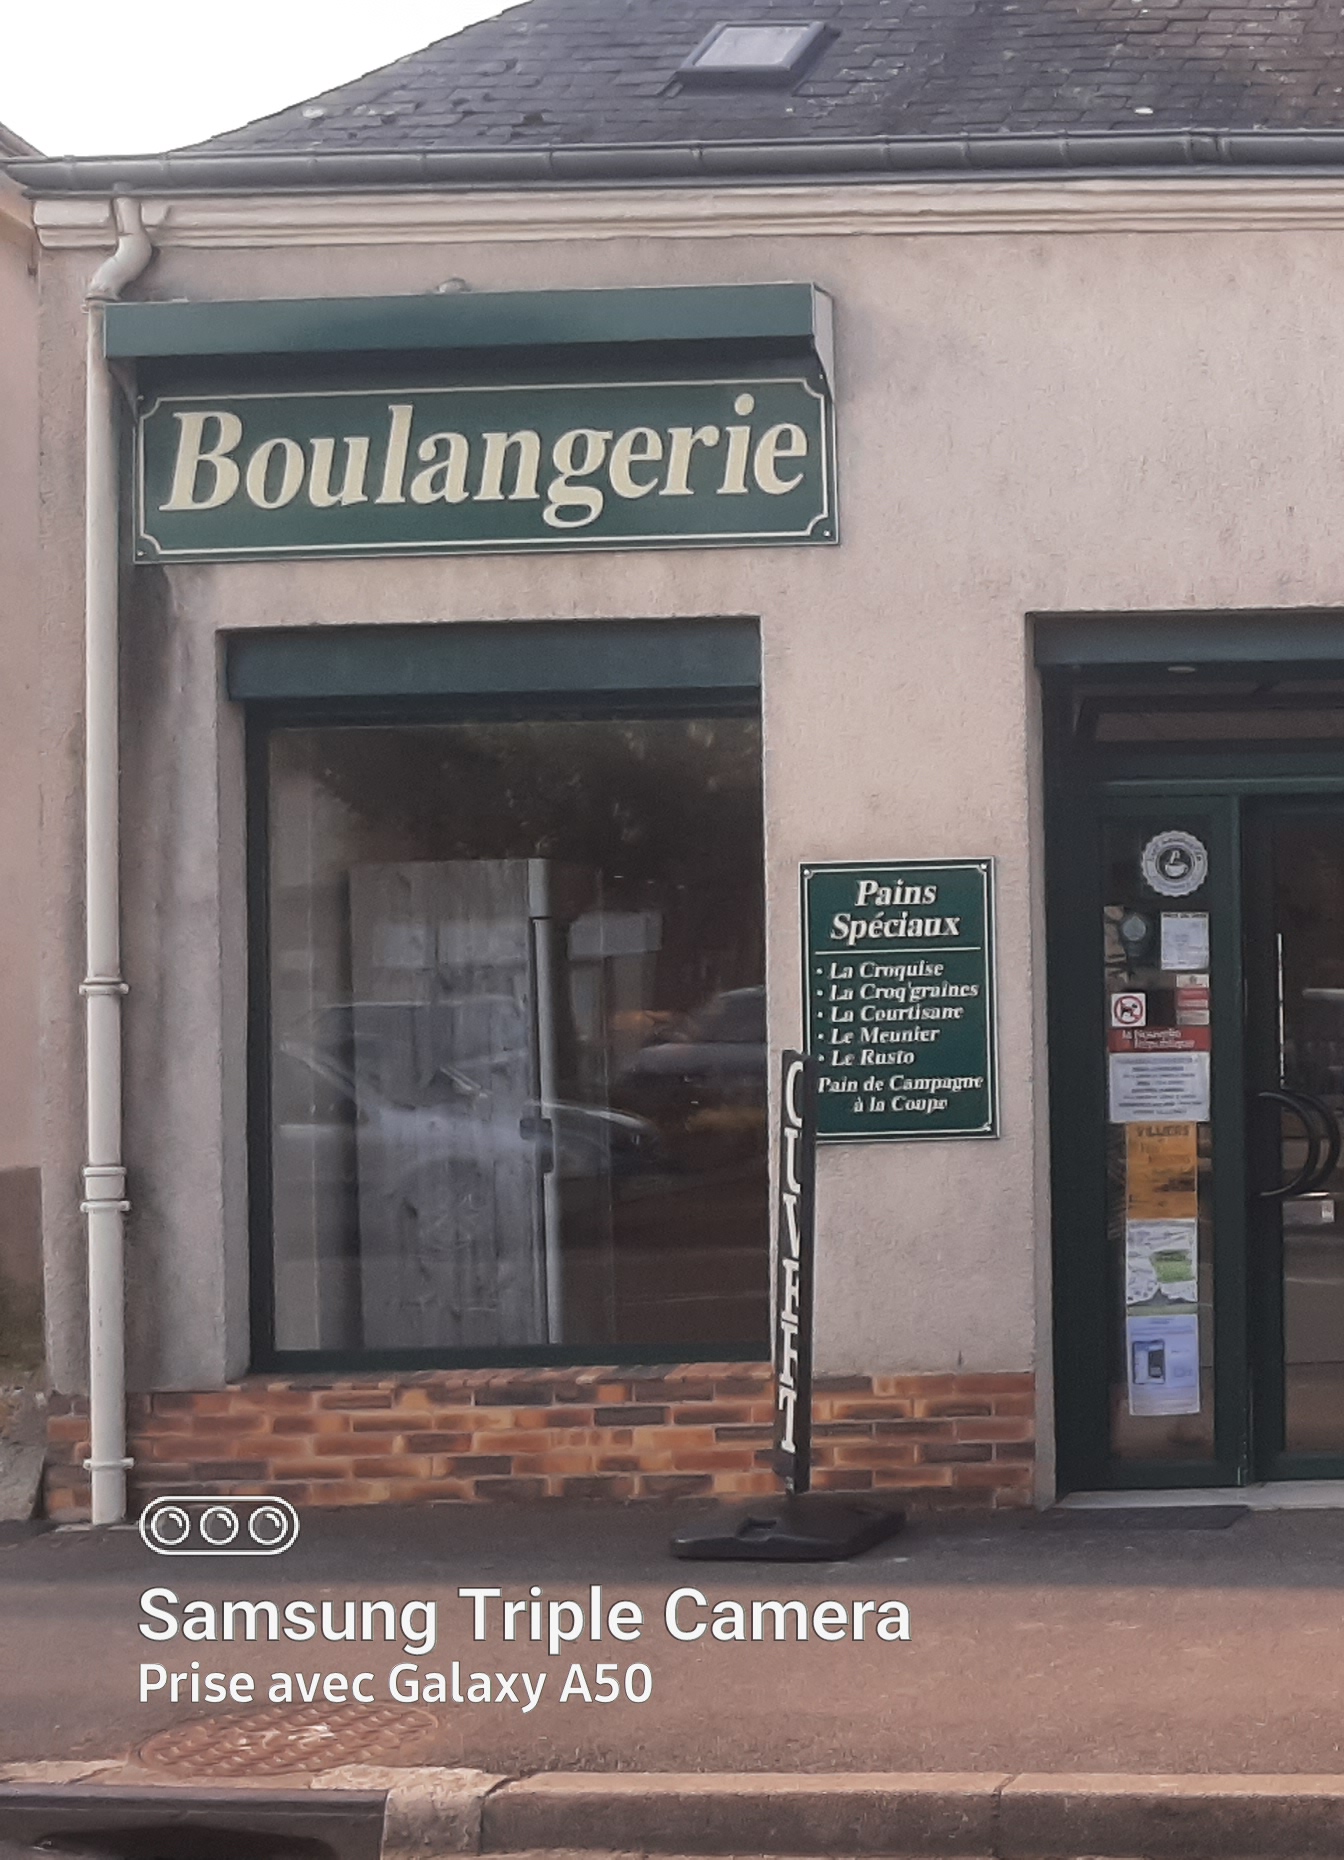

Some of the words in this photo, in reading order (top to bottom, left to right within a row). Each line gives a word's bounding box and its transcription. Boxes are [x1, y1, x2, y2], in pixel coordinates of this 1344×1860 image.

[158, 393, 807, 528] Boulangerie
[854, 879, 937, 906] Pains
[830, 911, 961, 946] Spéciaux
[830, 962, 854, 979] La
[860, 960, 944, 981] Croquise
[830, 984, 853, 1001] La
[830, 1006, 854, 1022] La
[860, 1004, 964, 1022] Courtisane
[830, 1028, 854, 1045] Le
[860, 1026, 940, 1044] Meunier
[831, 1050, 855, 1066] Le
[818, 1076, 858, 1093] Pain
[863, 1075, 884, 1092] de
[889, 1075, 983, 1093] Campagne
[853, 1096, 864, 1112] à
[869, 1096, 885, 1112] la
[891, 1095, 948, 1114] Coupe
